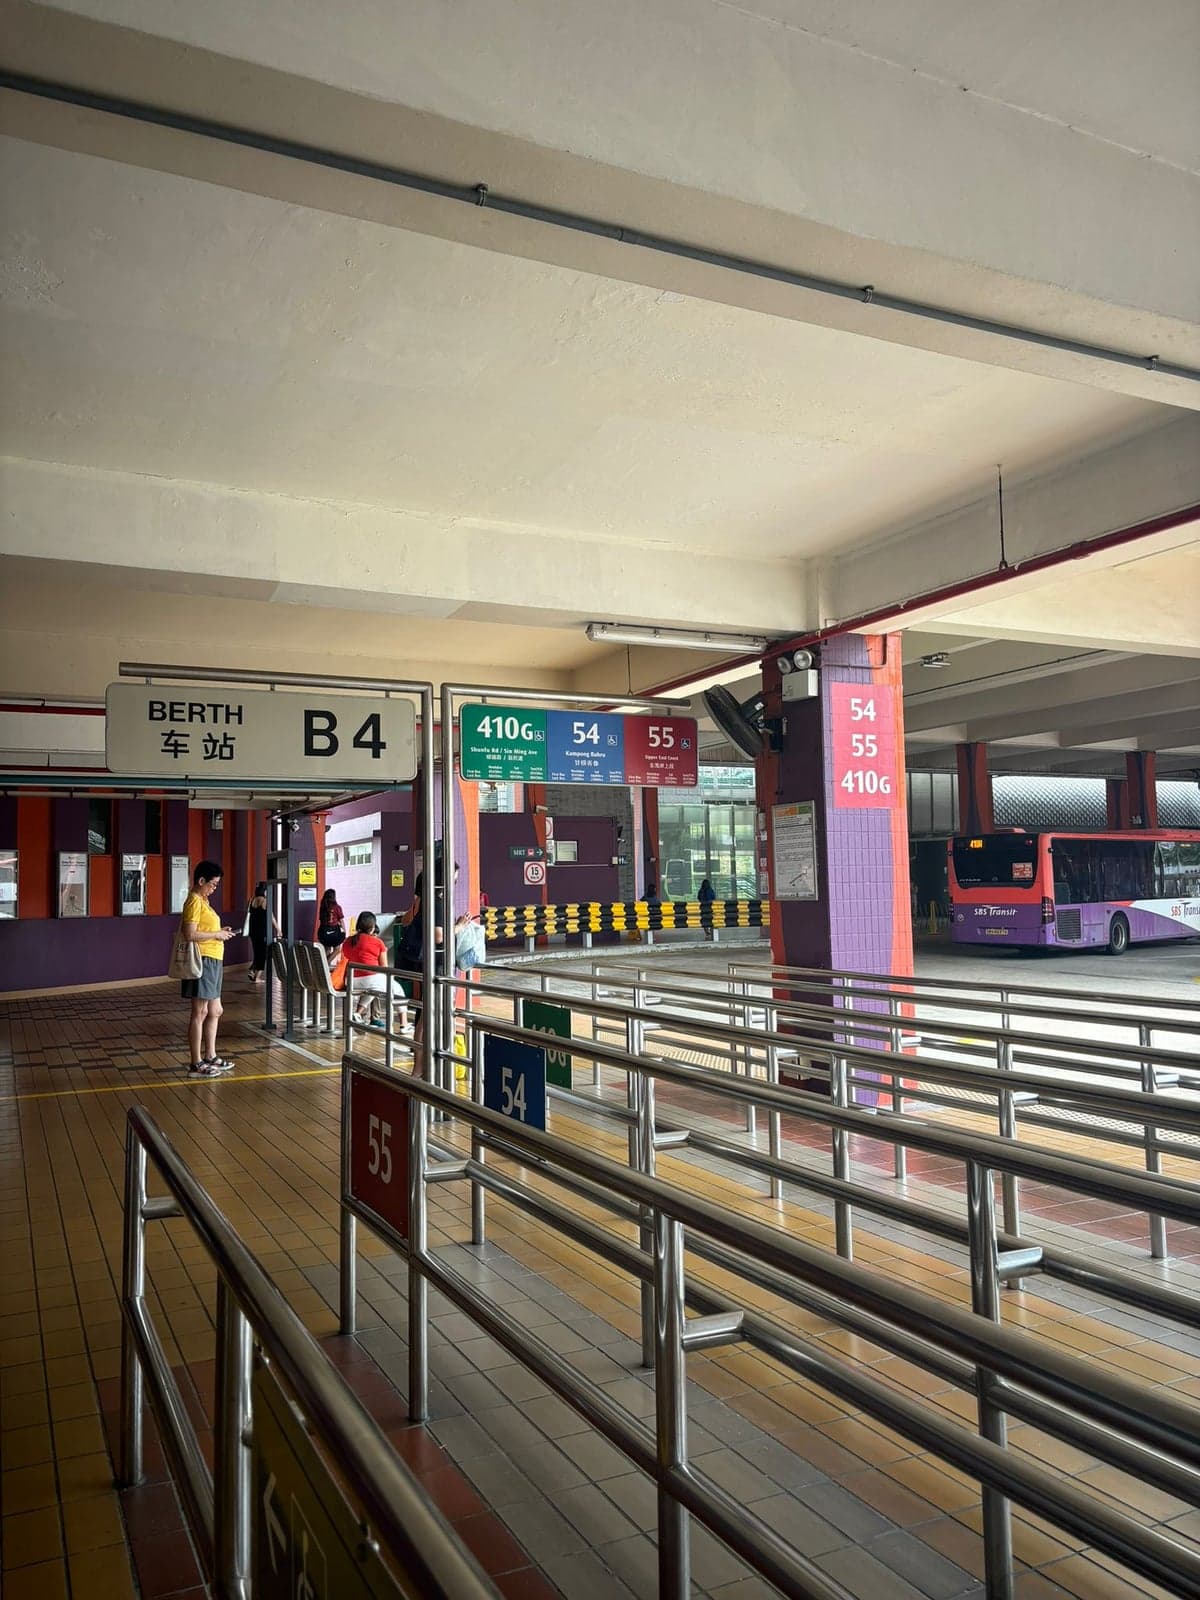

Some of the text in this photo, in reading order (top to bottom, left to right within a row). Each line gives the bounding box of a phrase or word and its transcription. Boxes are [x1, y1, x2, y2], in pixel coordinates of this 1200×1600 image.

[148, 700, 243, 731] BERTH
[850, 697, 876, 722] 54
[476, 715, 534, 741] 410G
[573, 721, 600, 745] 54
[648, 726, 675, 748] 55
[160, 730, 237, 761] 车站
[851, 733, 878, 758] 55
[840, 769, 891, 794] 410G
[531, 866, 539, 876] 15
[974, 905, 1017, 917] SBS Transit
[1171, 905, 1182, 917] SBS
[502, 1066, 527, 1122] 54
[368, 1113, 393, 1185] 55
